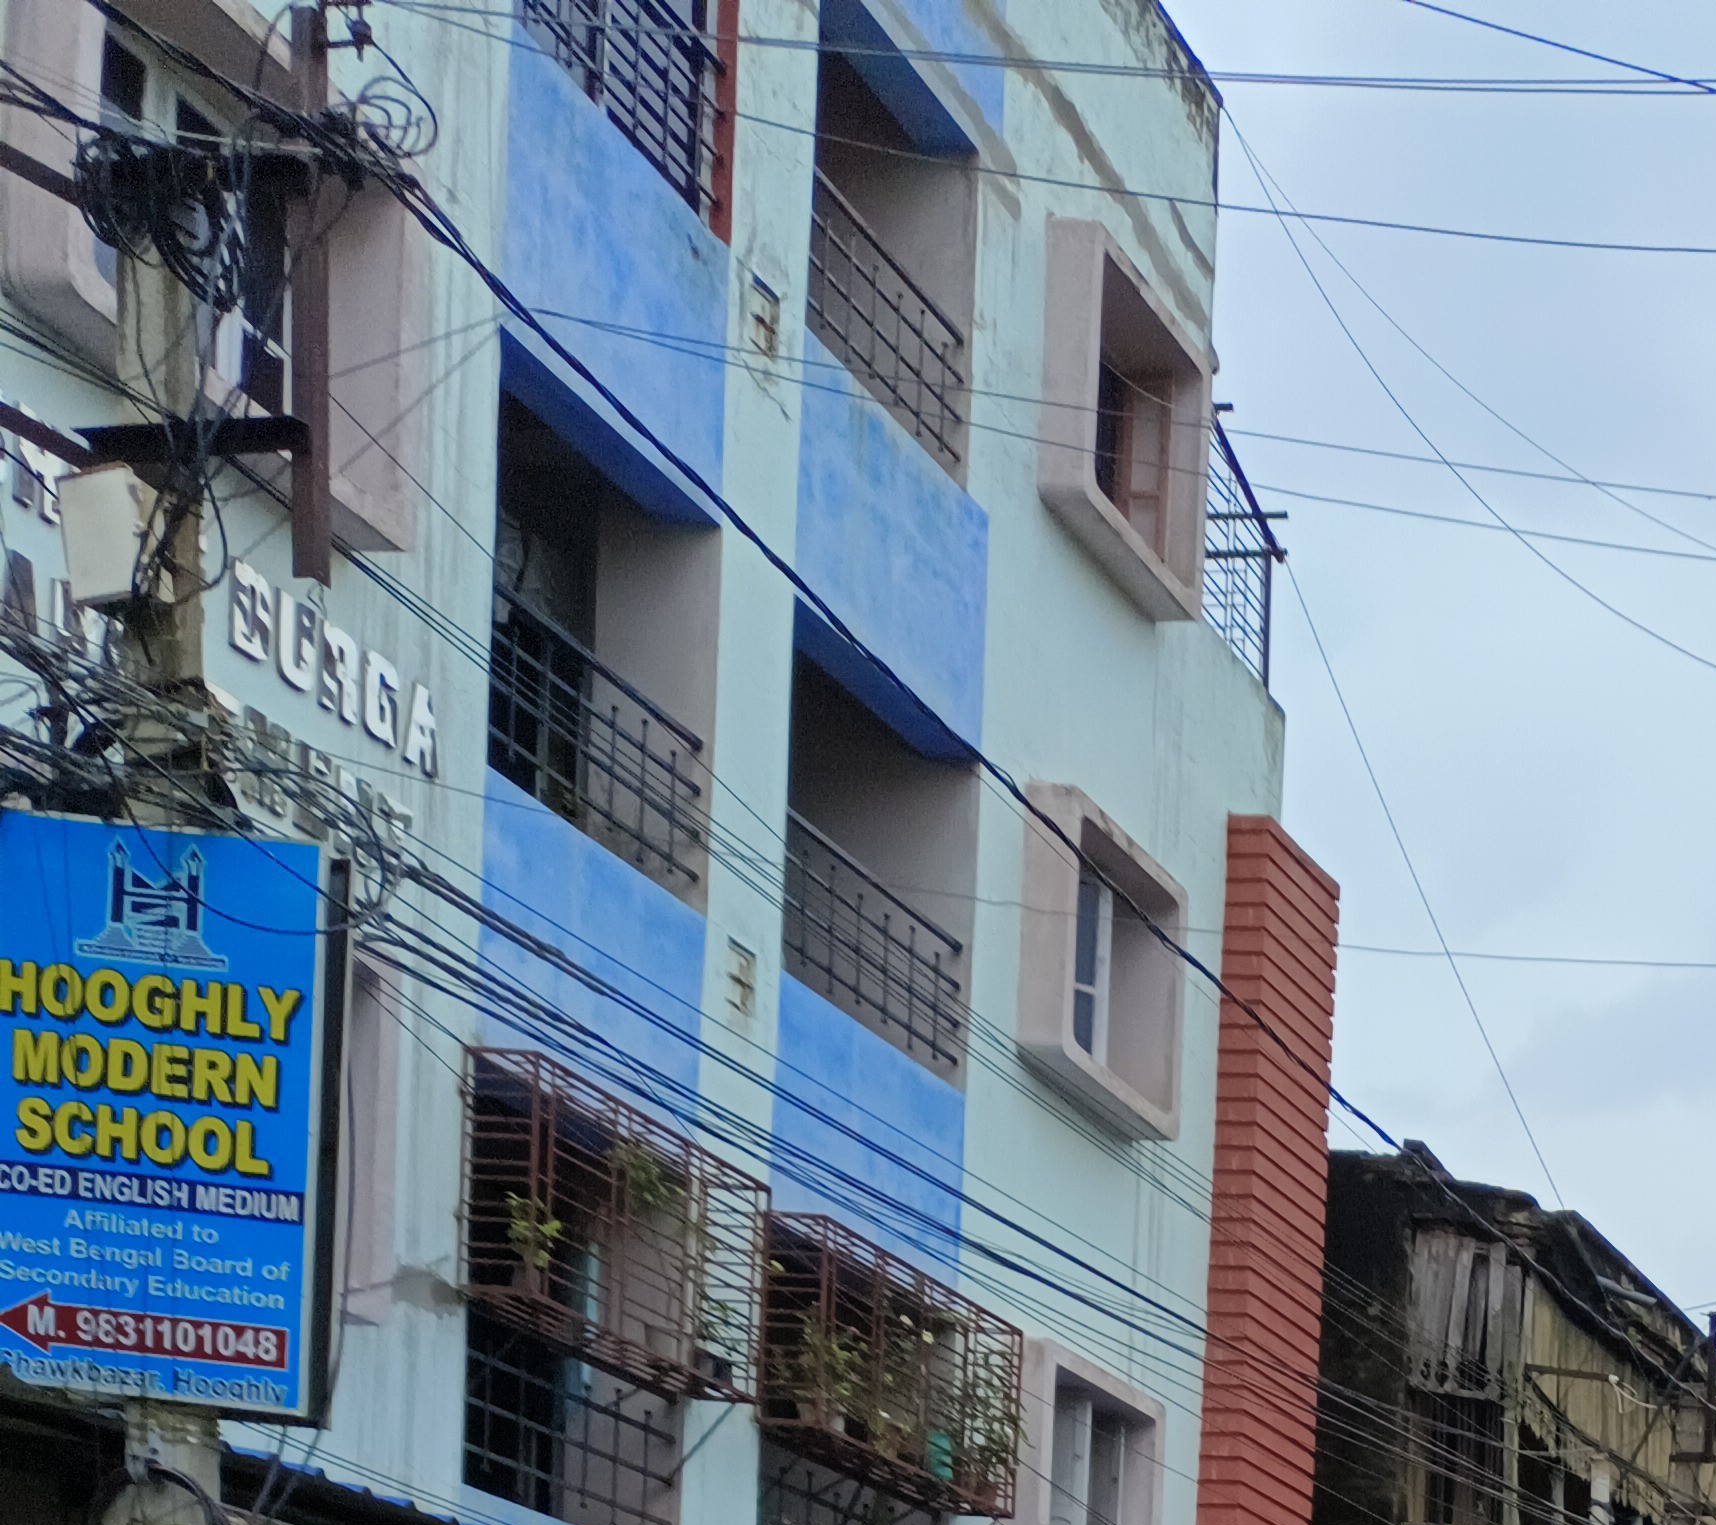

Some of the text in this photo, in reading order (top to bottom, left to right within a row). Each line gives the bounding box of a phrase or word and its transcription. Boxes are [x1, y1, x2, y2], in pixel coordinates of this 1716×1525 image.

[0, 959, 302, 1042] HOOGHLY
[12, 1028, 278, 1109] MODERN
[16, 1096, 271, 1176] SCHOOL
[0, 1163, 300, 1222] CO-ED ENGLISH MEDIUM
[0, 1231, 291, 1282] West Bengal Board of
[64, 1209, 219, 1245] Affiliated to
[0, 1260, 285, 1310] Secondary Education
[27, 1303, 278, 1362] M. 9831101048
[173, 1366, 288, 1404] Hooghly
